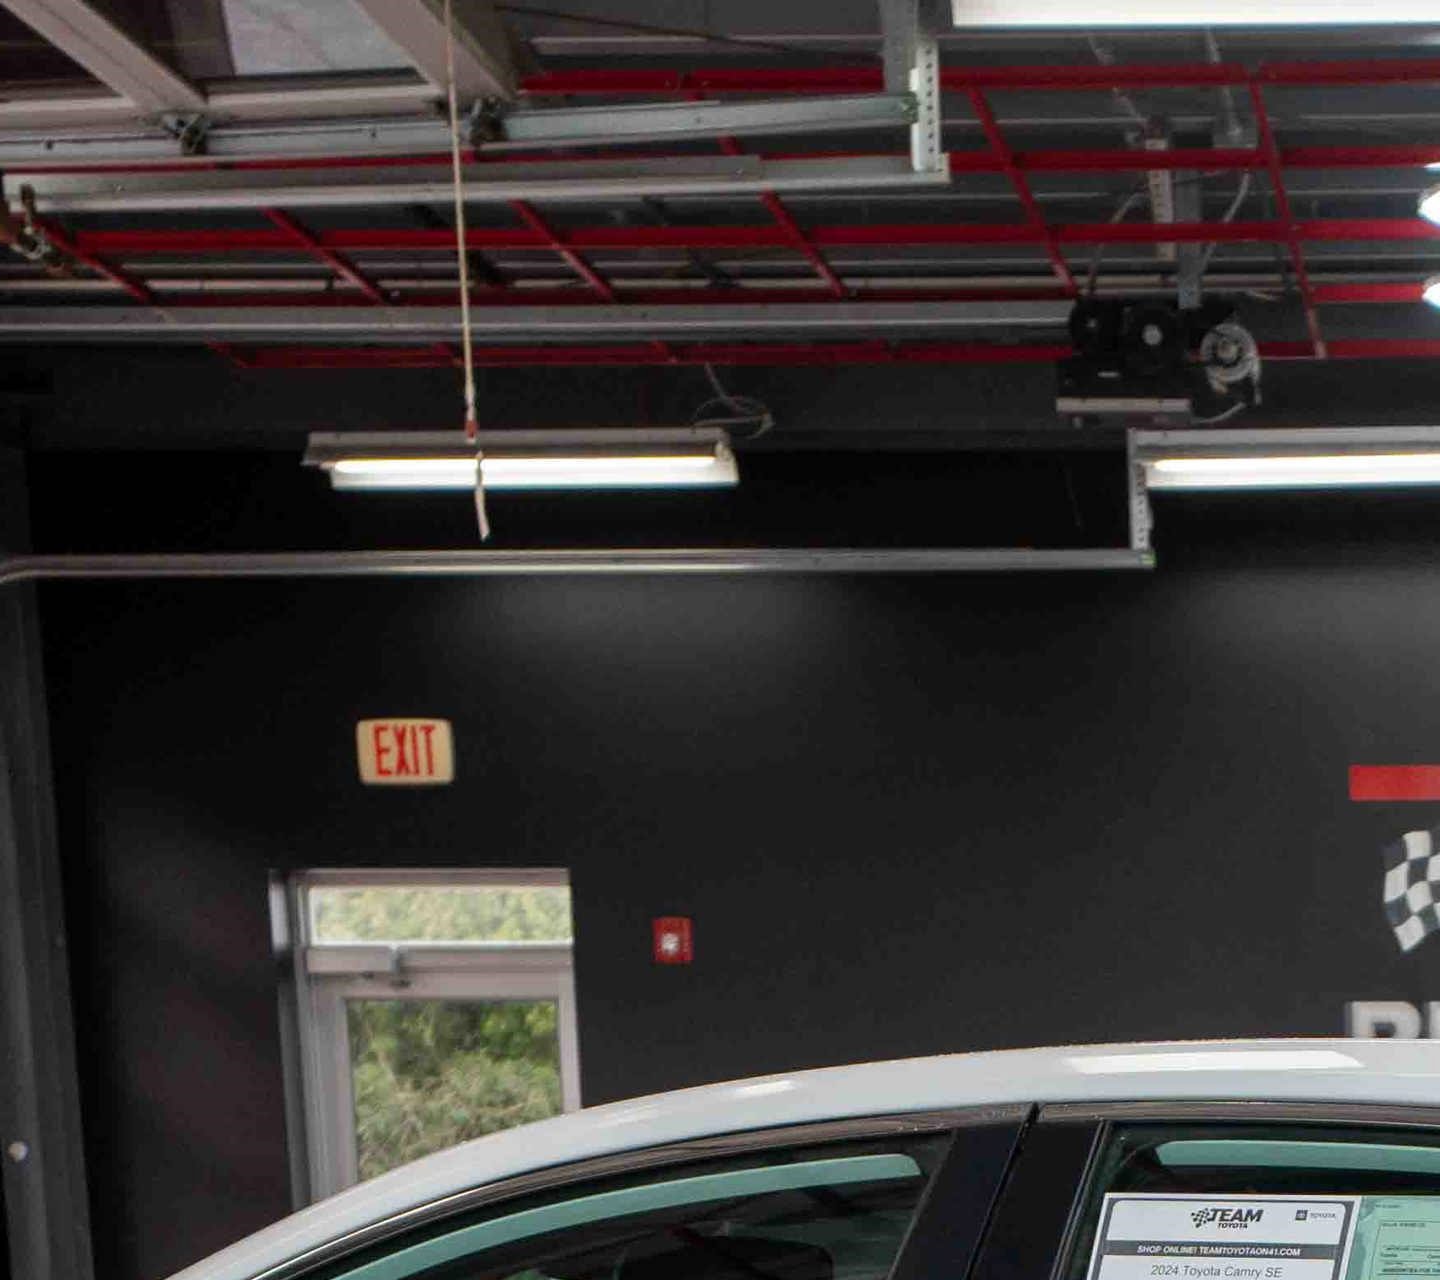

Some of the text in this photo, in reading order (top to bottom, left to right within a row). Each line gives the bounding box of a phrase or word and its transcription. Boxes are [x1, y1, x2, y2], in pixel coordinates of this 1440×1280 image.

[373, 723, 435, 777] EXIT
[1210, 1208, 1264, 1222] TEAM
[1217, 1222, 1248, 1230] TOYOTA
[1137, 1245, 1161, 1254] SHOP
[1163, 1246, 1198, 1255] ONLINE!
[1151, 1264, 1283, 1280] 2024 Toyota Camry SE
